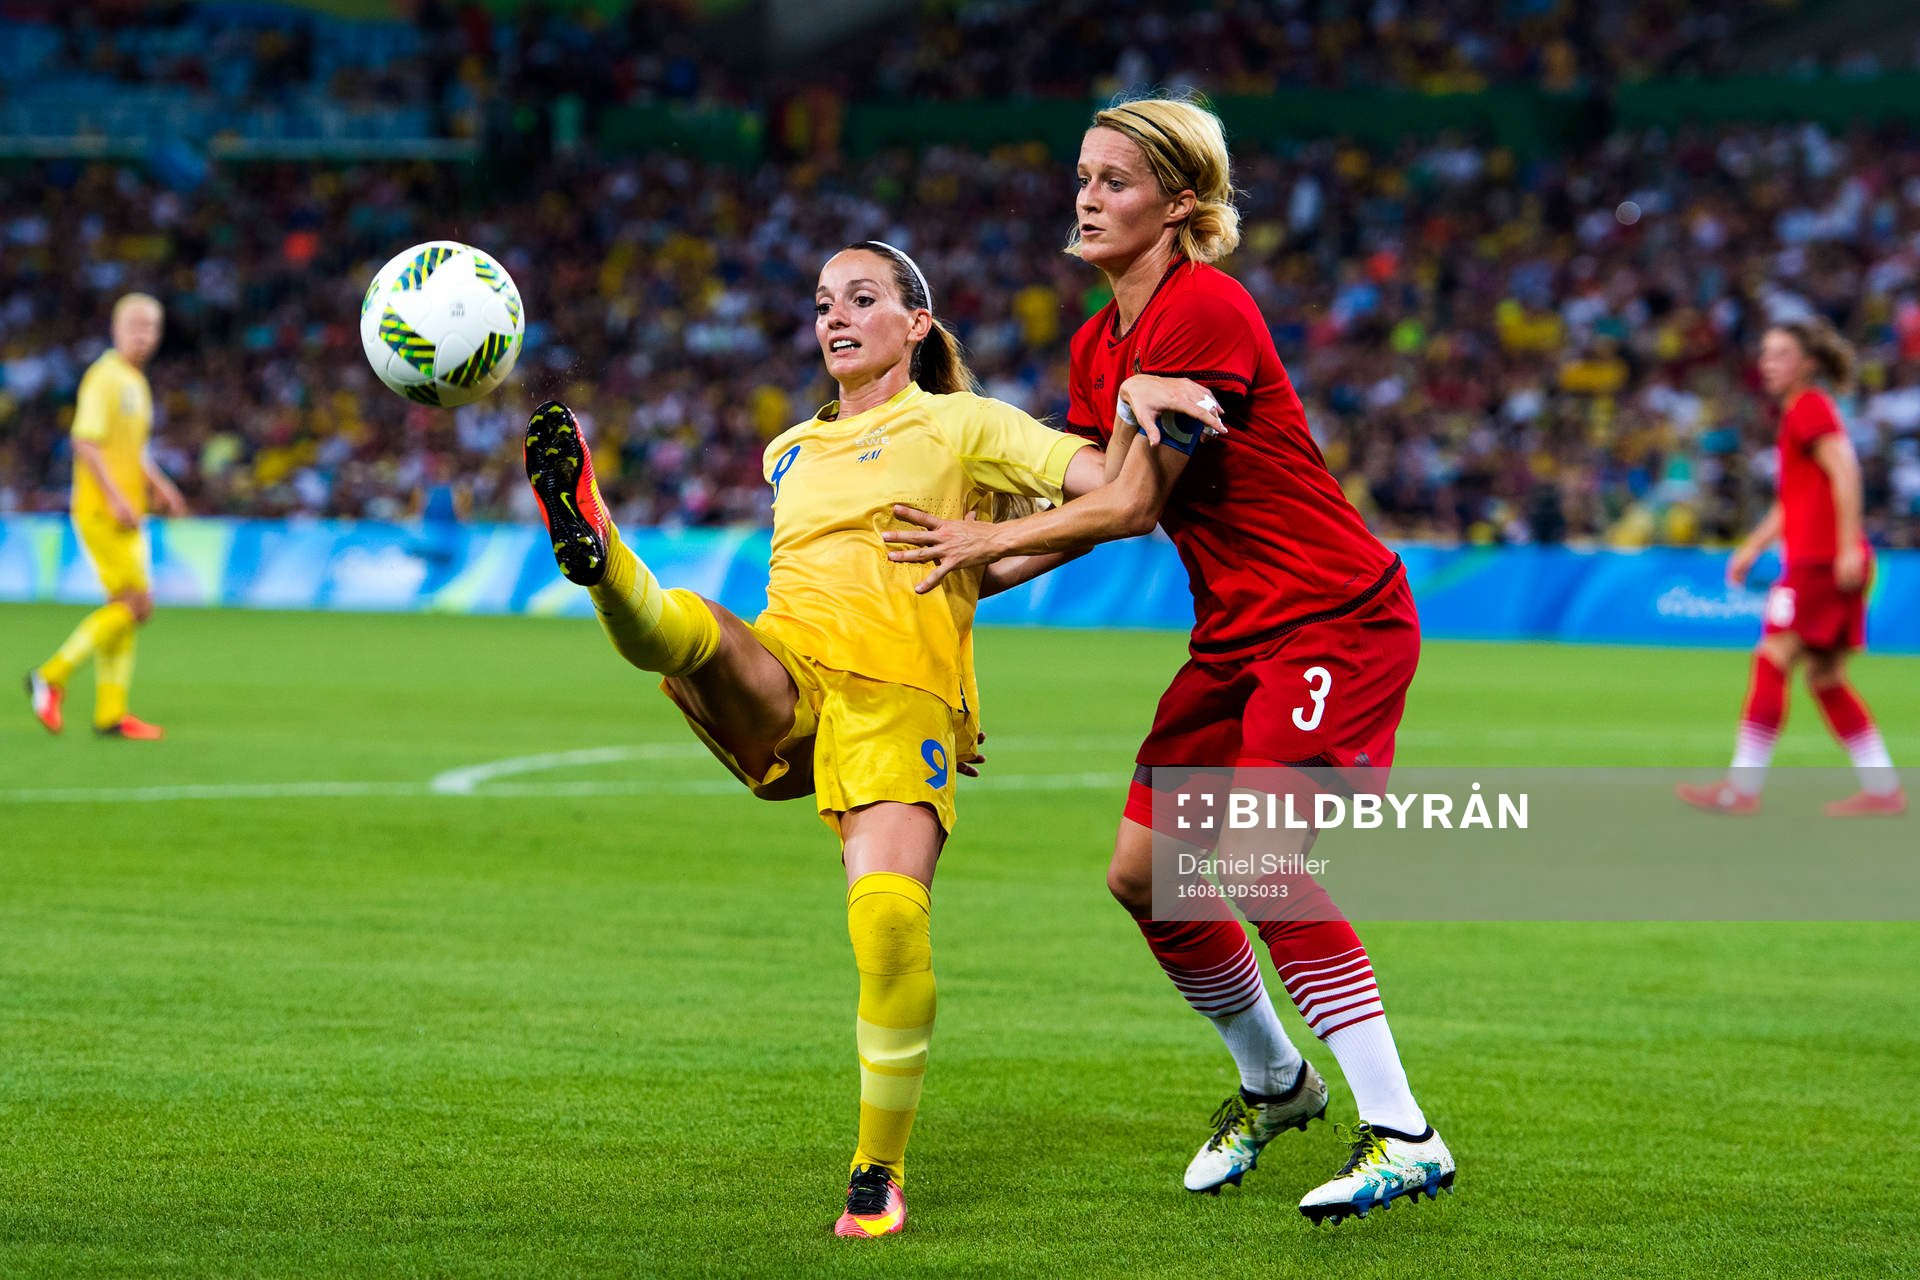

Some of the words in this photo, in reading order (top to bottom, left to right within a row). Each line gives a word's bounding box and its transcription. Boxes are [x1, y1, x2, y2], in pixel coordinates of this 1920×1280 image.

[771, 445, 801, 498] 9
[1292, 666, 1332, 731] 3
[921, 739, 948, 789] 9
